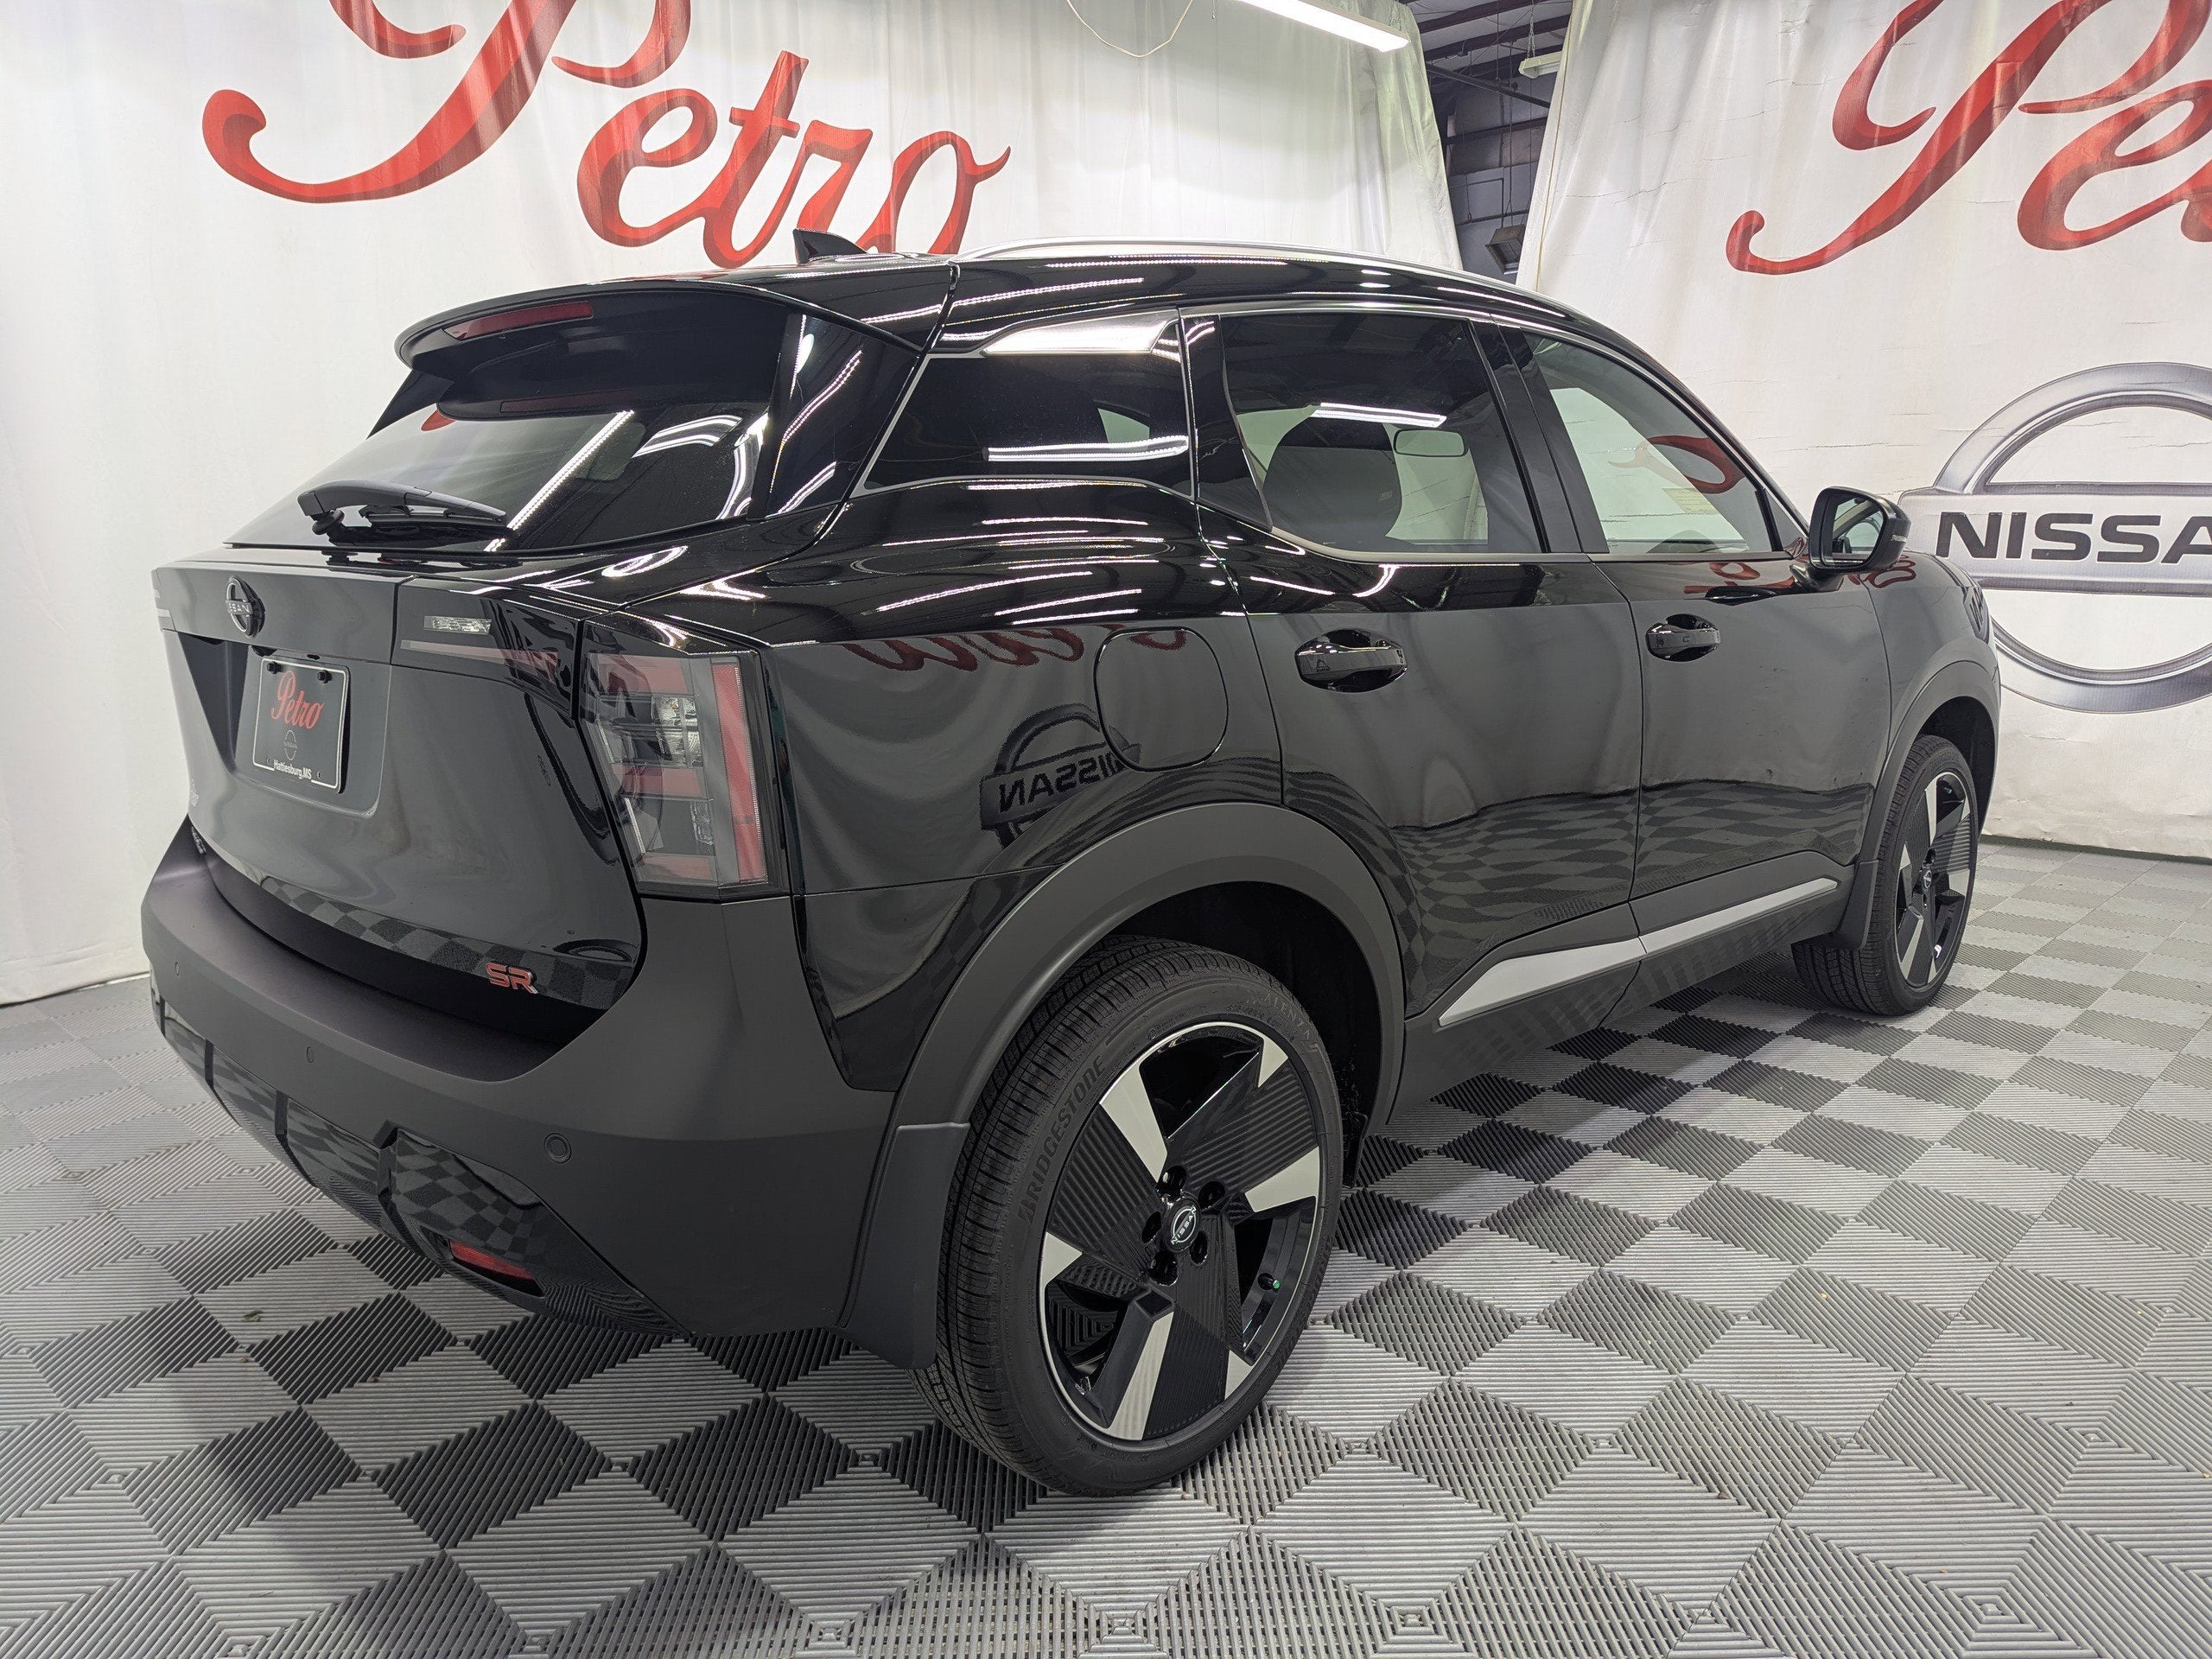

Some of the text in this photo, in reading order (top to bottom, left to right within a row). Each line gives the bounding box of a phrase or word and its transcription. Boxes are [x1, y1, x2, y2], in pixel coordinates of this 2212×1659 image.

[270, 671, 325, 729] Petro
[486, 962, 538, 994] SR
[1018, 1055, 1105, 1224] BRIDGESTONE
